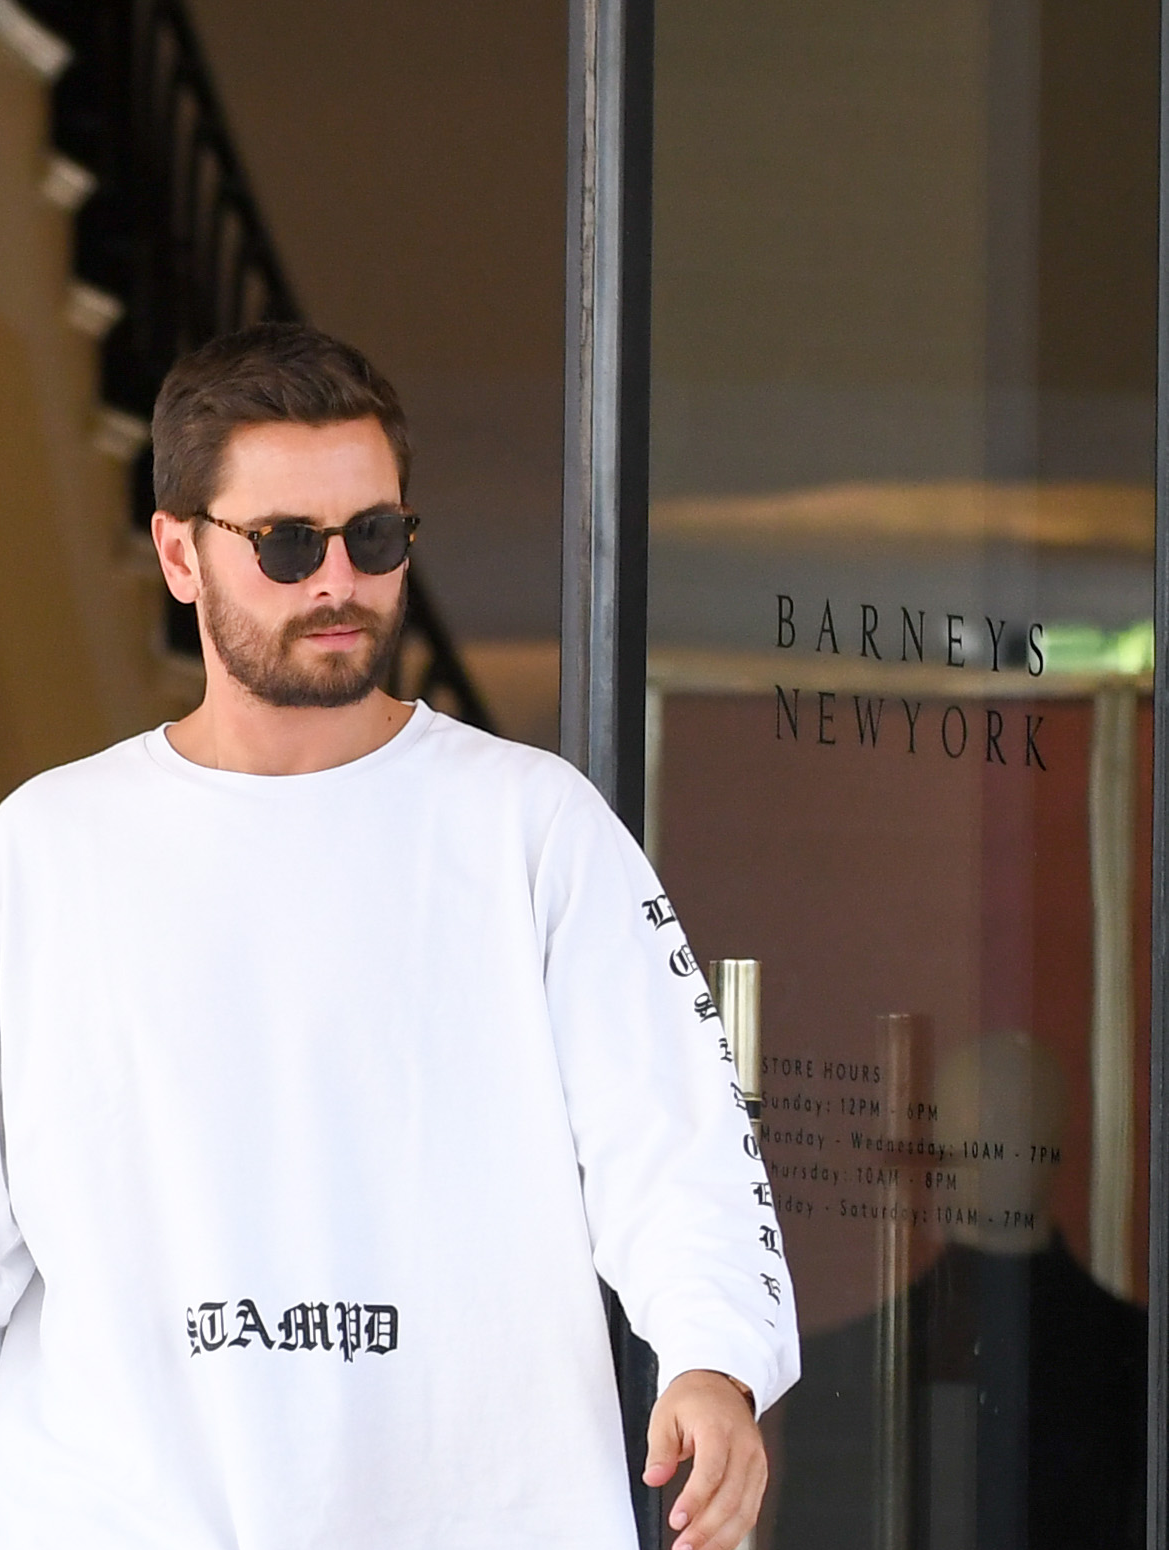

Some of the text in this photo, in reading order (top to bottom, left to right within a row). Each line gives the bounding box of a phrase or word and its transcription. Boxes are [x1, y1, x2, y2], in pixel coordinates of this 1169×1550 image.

[776, 594, 1044, 677] BARNEYS
[762, 1057, 881, 1083] STORE HOURS
[762, 1091, 831, 1117] Sunday:
[840, 1098, 880, 1117] 12PM
[906, 1102, 938, 1121] 6PM
[760, 1124, 825, 1150] Monday
[851, 1131, 954, 1161] Wednesday:
[963, 1141, 1004, 1160] 10AM
[1030, 1145, 1061, 1164] 7PM
[771, 1162, 848, 1186] hursday:
[857, 1167, 899, 1186] 10AM
[925, 1172, 957, 1190] 8PM
[777, 1195, 814, 1219] iday
[840, 1199, 927, 1227] Saturday:
[937, 1207, 978, 1225] 10AM
[1004, 1211, 1034, 1230] 7PM
